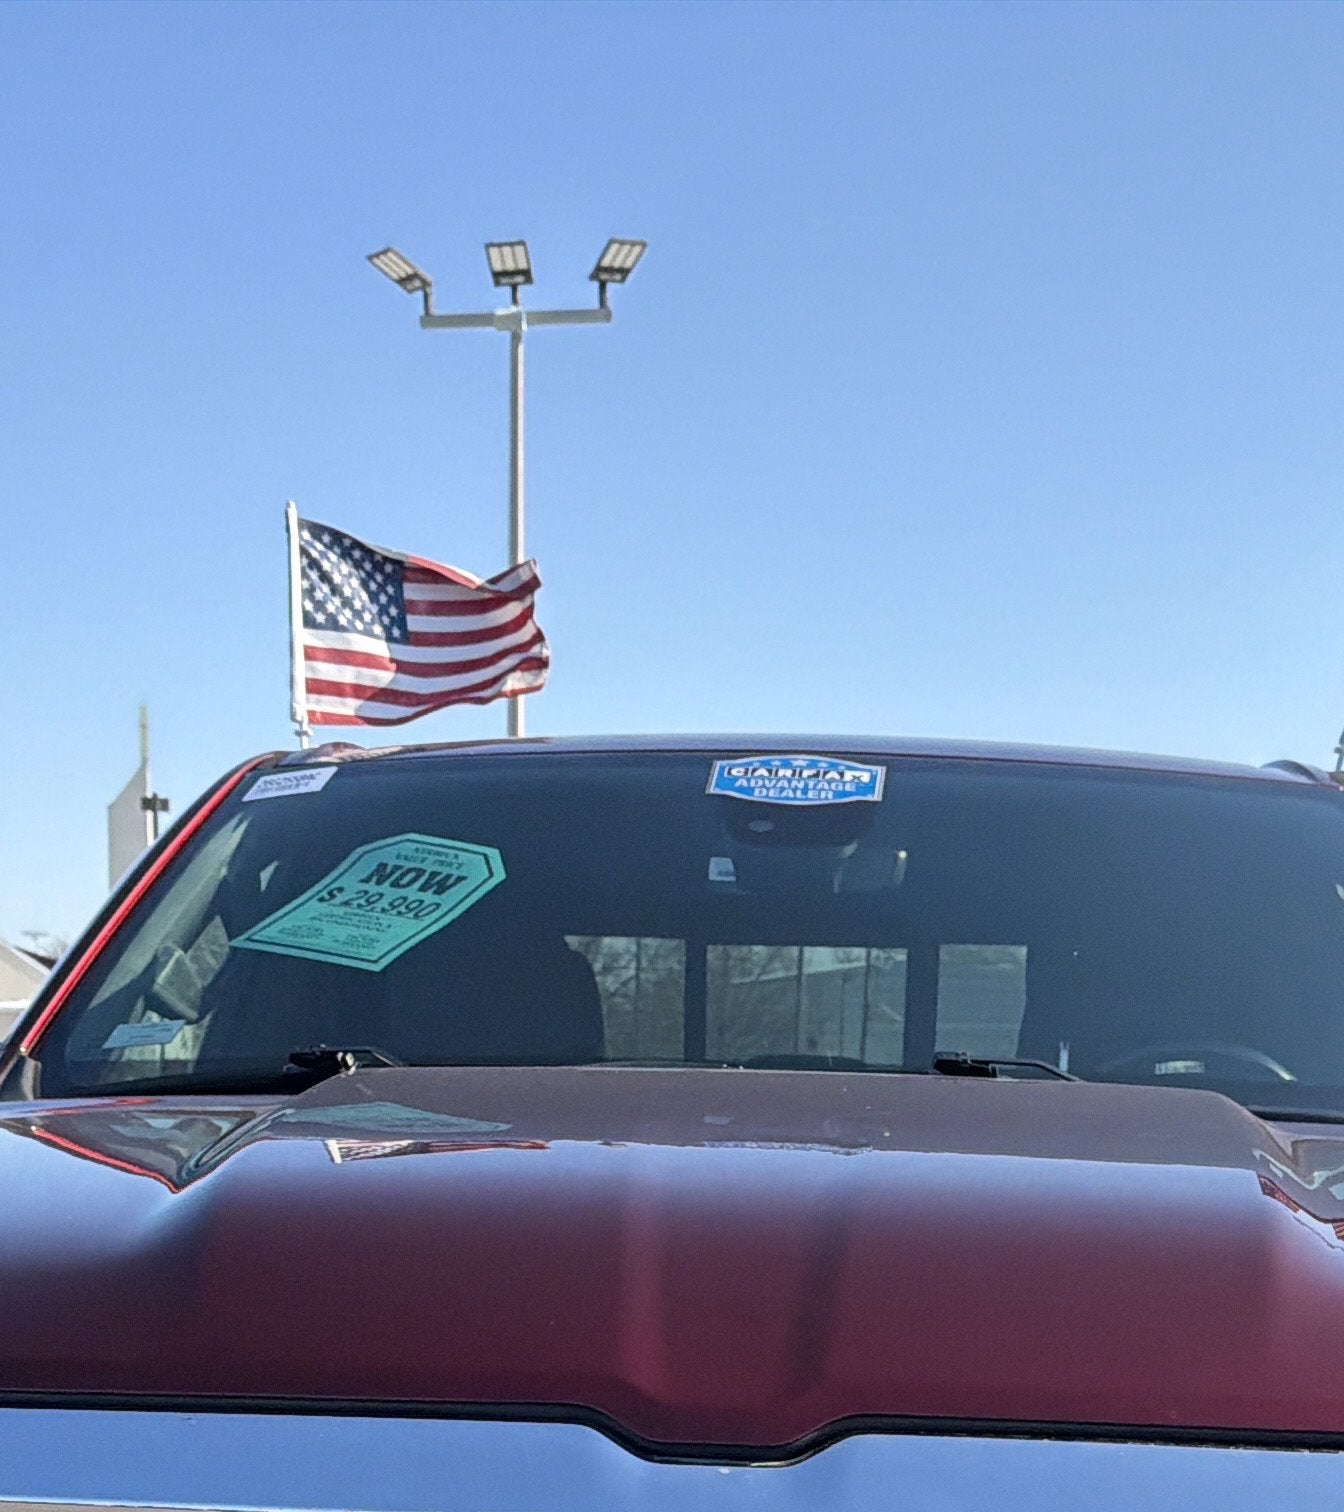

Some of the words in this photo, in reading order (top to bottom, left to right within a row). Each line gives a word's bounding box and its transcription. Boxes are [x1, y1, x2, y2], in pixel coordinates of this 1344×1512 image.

[725, 766, 871, 783] CARFAX
[734, 778, 857, 792] ADVANTAGE
[753, 788, 835, 800] DEALER
[359, 861, 468, 897] NOW
